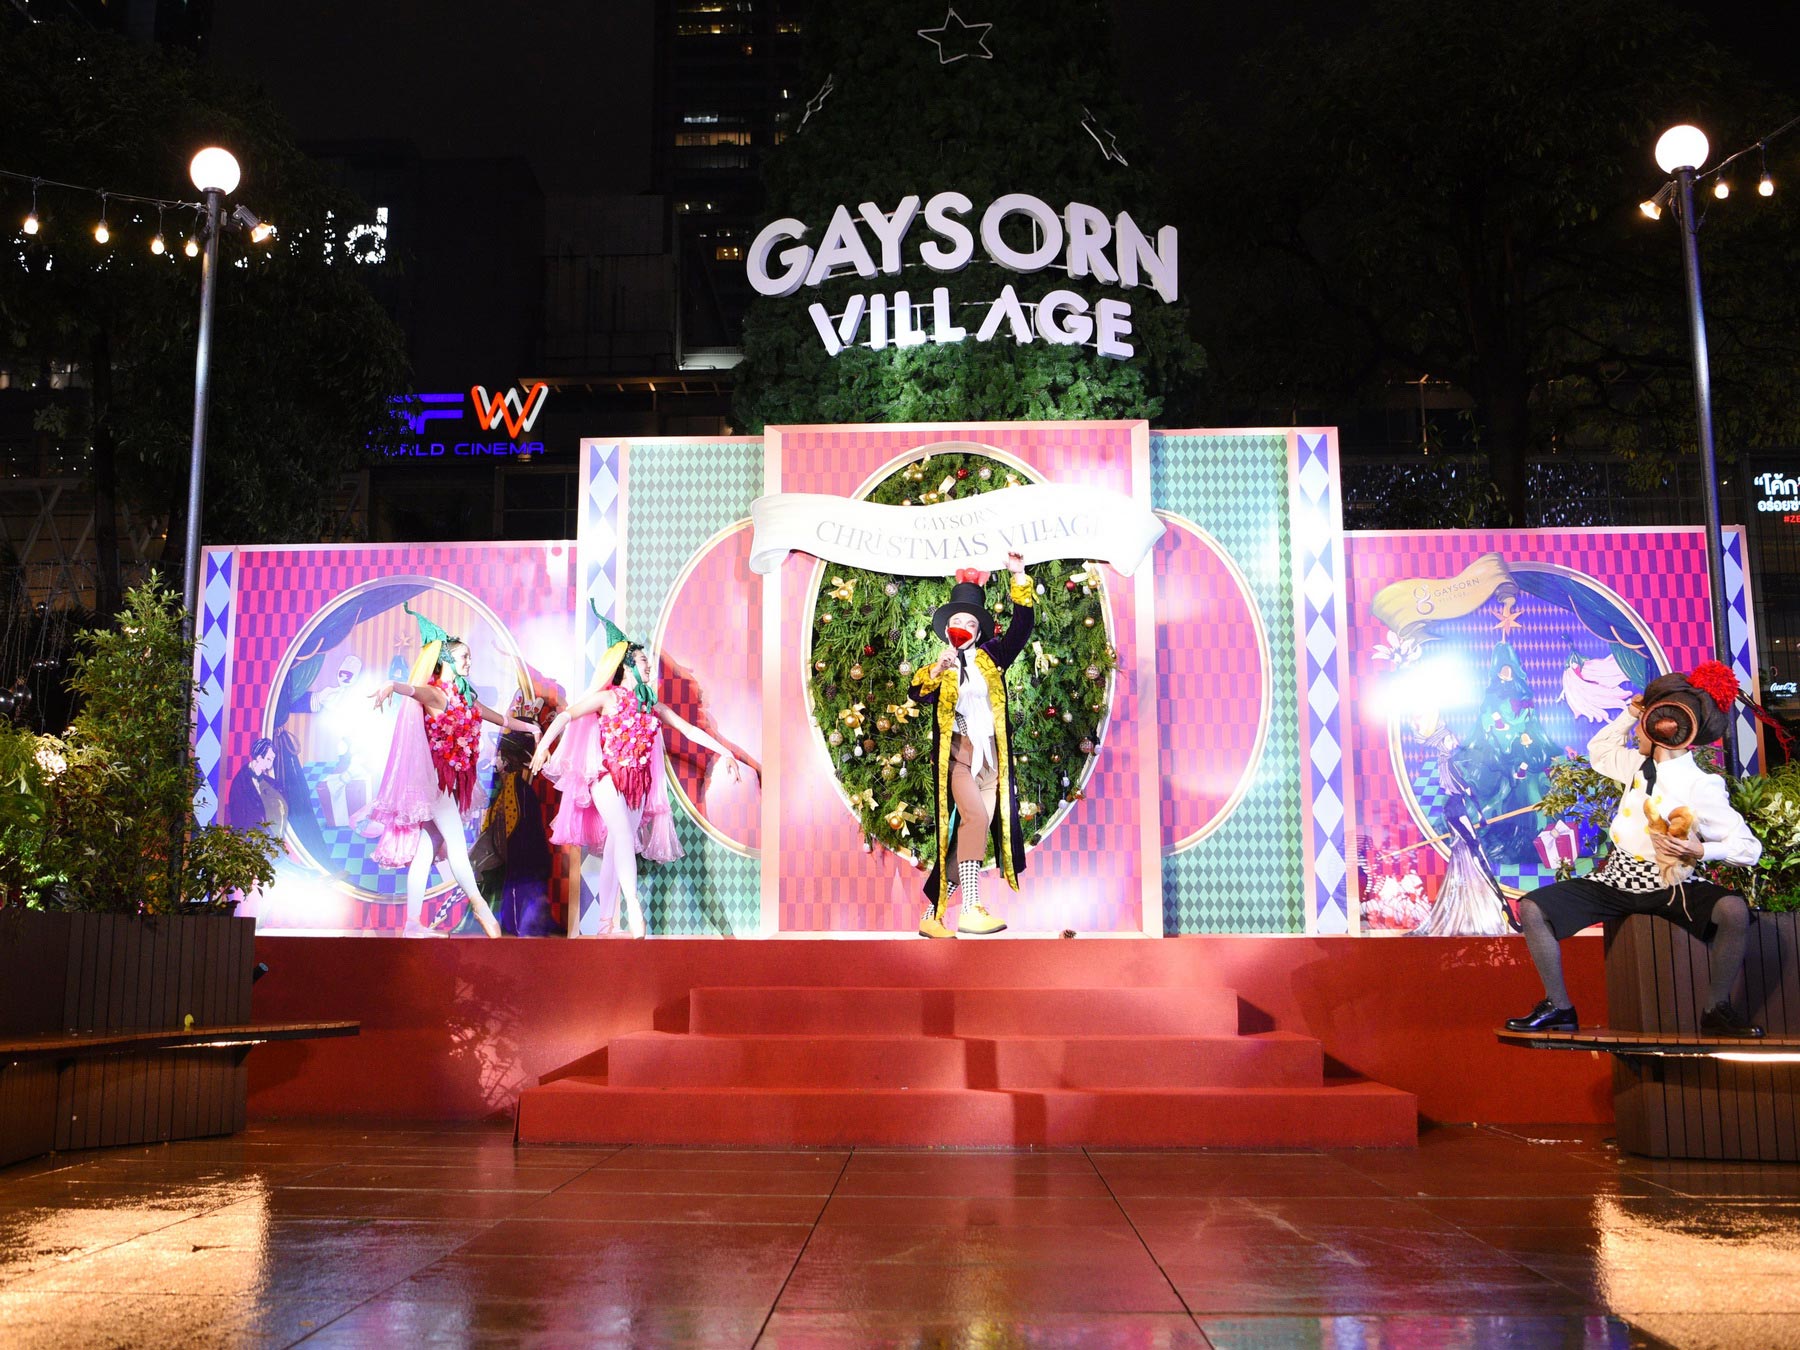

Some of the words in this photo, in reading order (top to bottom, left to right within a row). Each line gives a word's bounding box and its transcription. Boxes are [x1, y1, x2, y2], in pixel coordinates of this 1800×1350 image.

[746, 191, 1178, 303] GAYSORN
[808, 284, 1134, 360] VILLAGE
[366, 442, 445, 457] RLD
[454, 441, 545, 457] CINEMA
[998, 512, 1103, 548] VILLAG
[1434, 577, 1480, 597] GAYSORN
